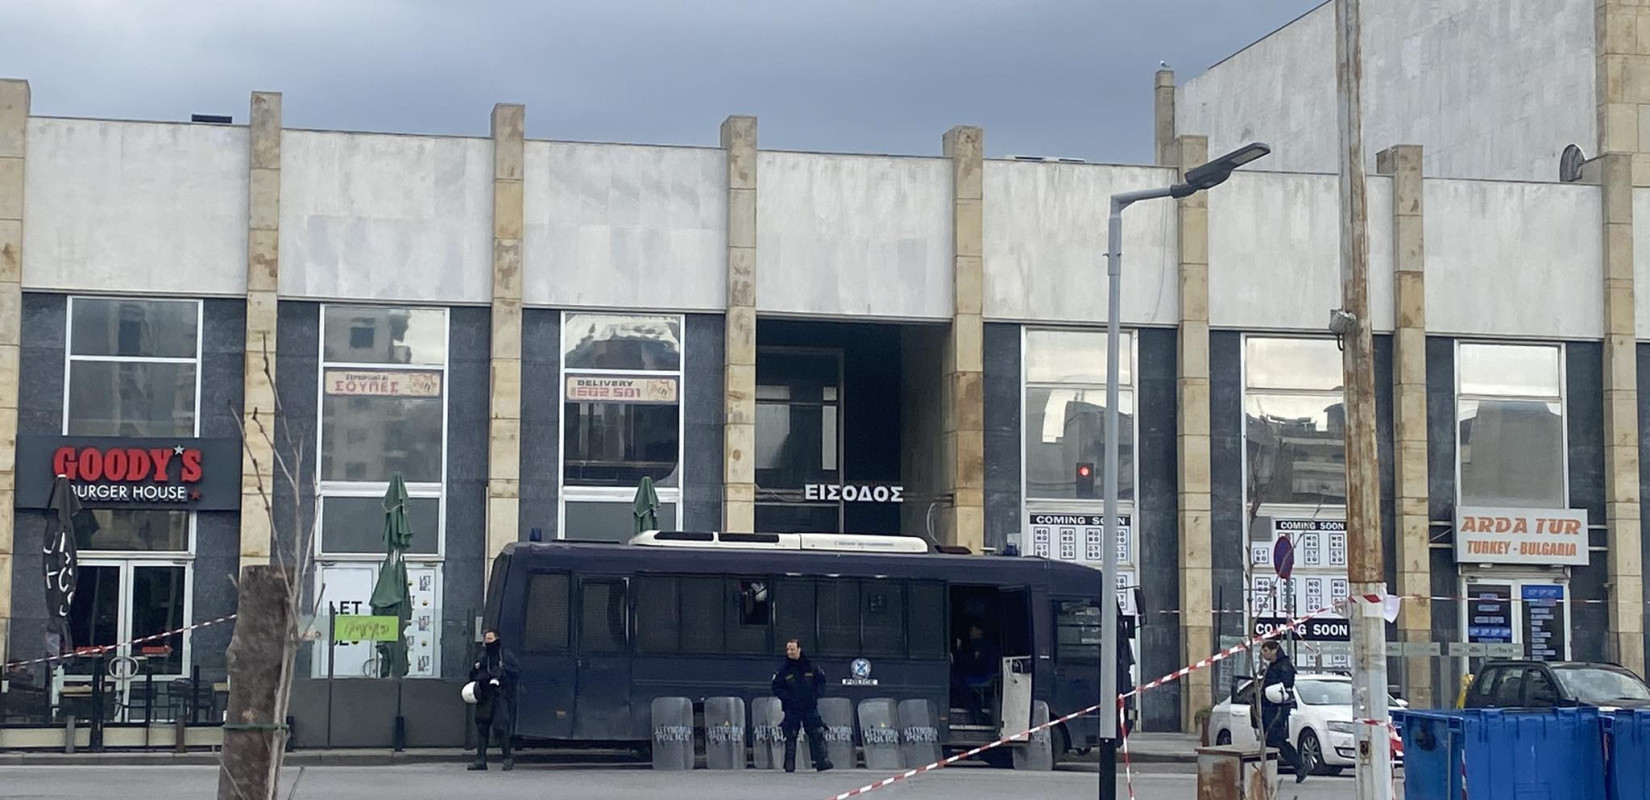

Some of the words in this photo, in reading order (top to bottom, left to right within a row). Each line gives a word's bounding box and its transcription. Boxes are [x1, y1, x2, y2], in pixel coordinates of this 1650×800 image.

[335, 381, 399, 393] ΣΟΥΠΕΣ
[613, 388, 640, 398] 501
[133, 486, 186, 499] HOUSE
[804, 484, 904, 502] ΕΙΣΟΔΟΣ
[1036, 515, 1086, 525] COMING
[1092, 517, 1125, 525] SN
[1280, 522, 1316, 530] COMING
[1320, 522, 1344, 530] SOON
[1460, 516, 1528, 533] ARDA
[1535, 518, 1582, 535] TUR
[1467, 540, 1511, 555] TURKEY
[1520, 541, 1577, 556] BULGARIA
[1313, 624, 1348, 636] SOON
[656, 734, 691, 742] POLICE
[709, 734, 744, 742] POLICE
[867, 735, 900, 743] POLICE
[906, 734, 938, 742] POLICE
